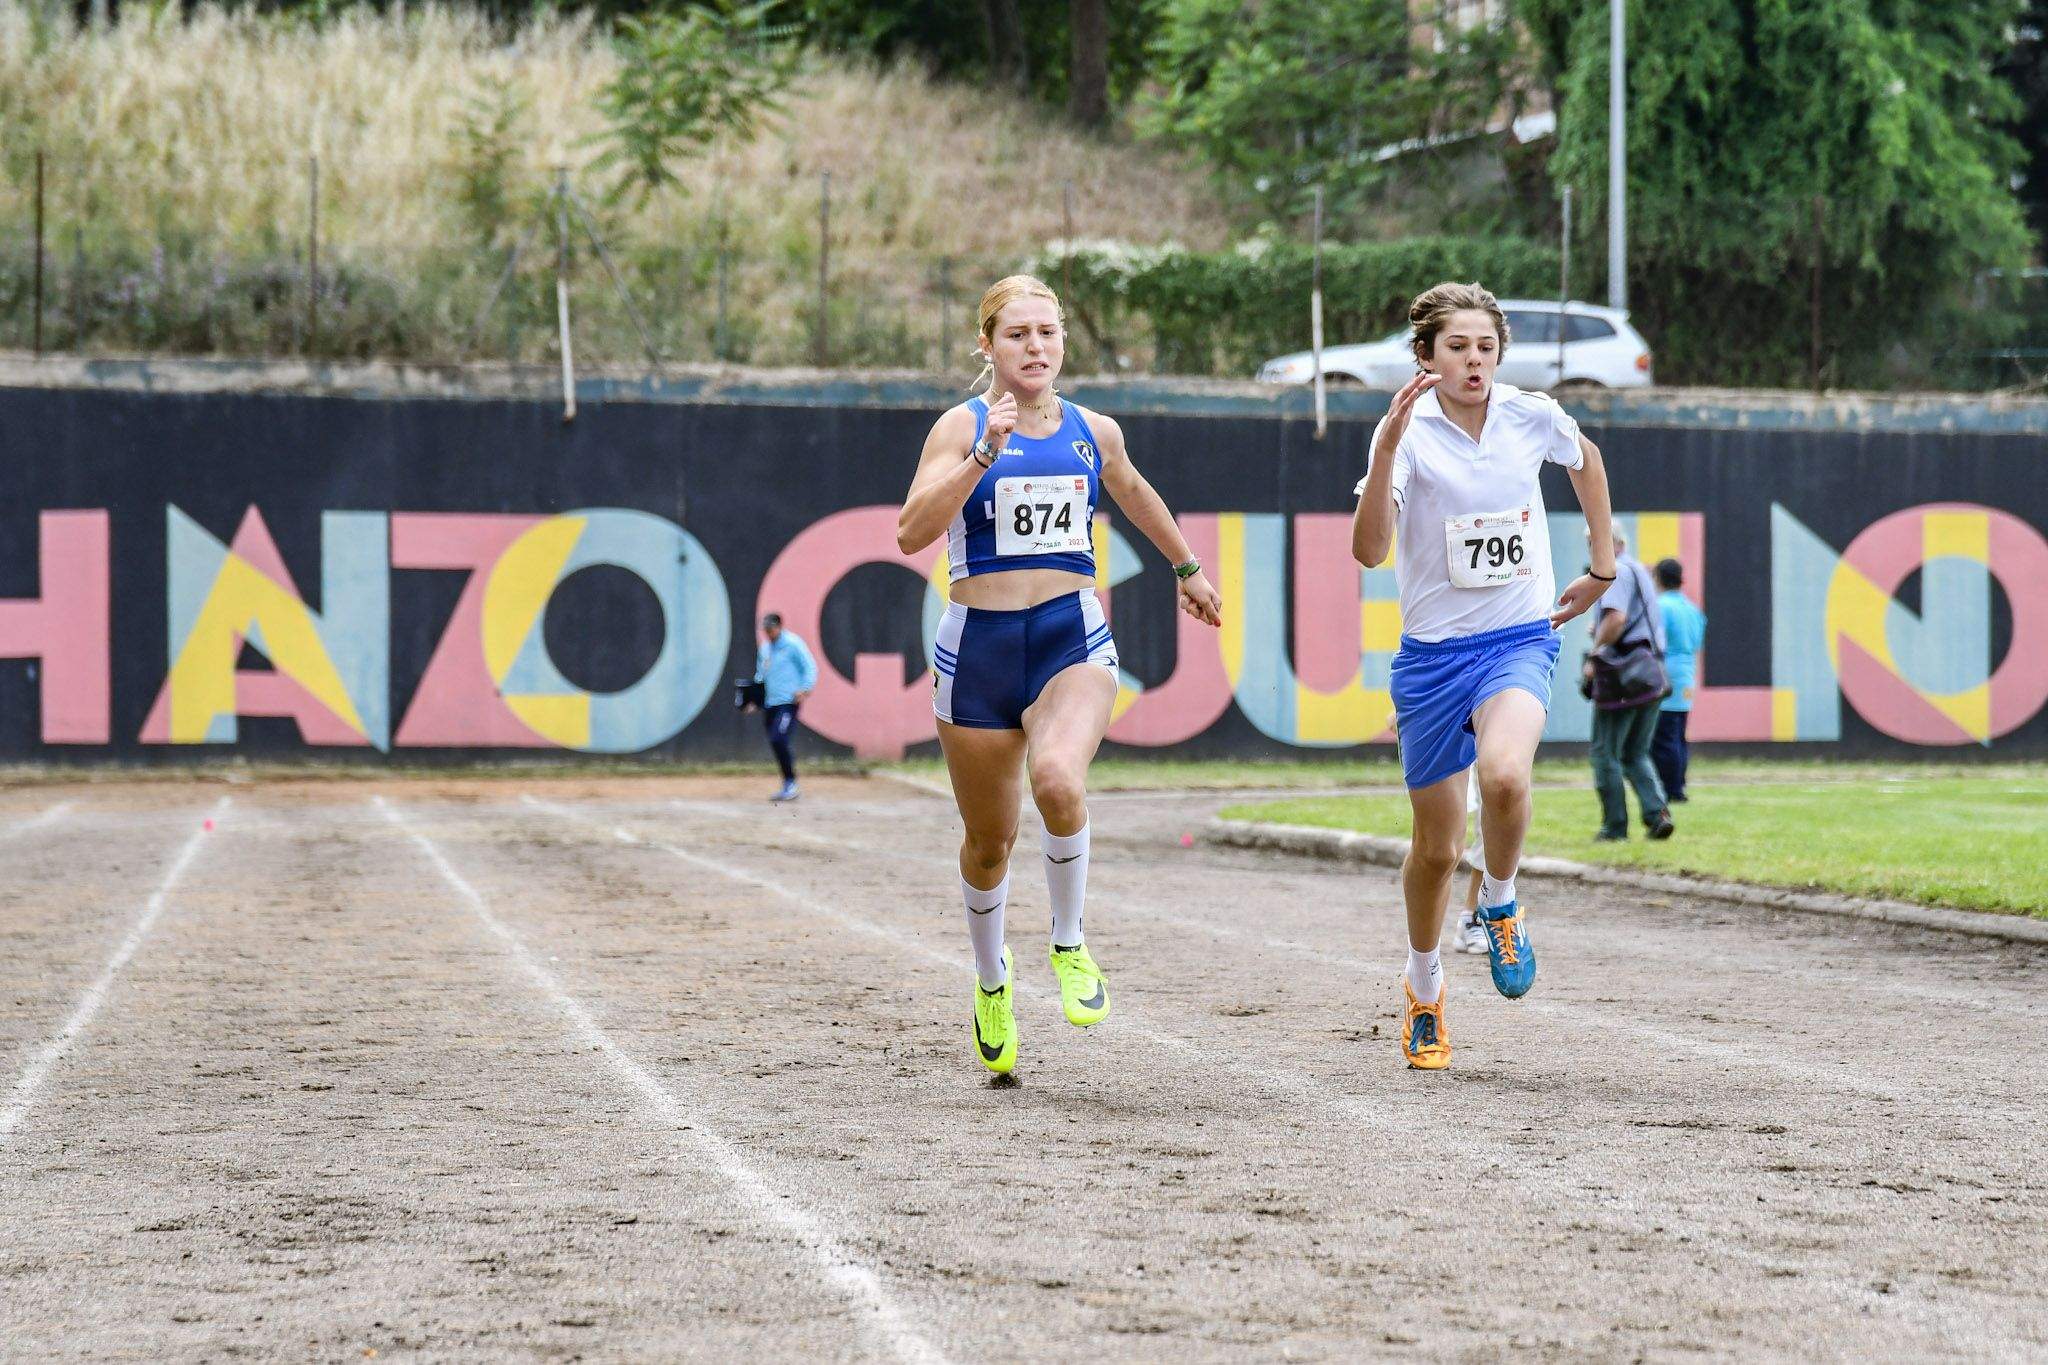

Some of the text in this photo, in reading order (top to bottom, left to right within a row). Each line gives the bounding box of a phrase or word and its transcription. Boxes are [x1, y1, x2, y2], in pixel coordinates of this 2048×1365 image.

[1013, 502, 1072, 536] 874
[1067, 538, 1085, 546] 2023
[1464, 534, 1524, 569] 796
[1516, 567, 1532, 576] 2023
